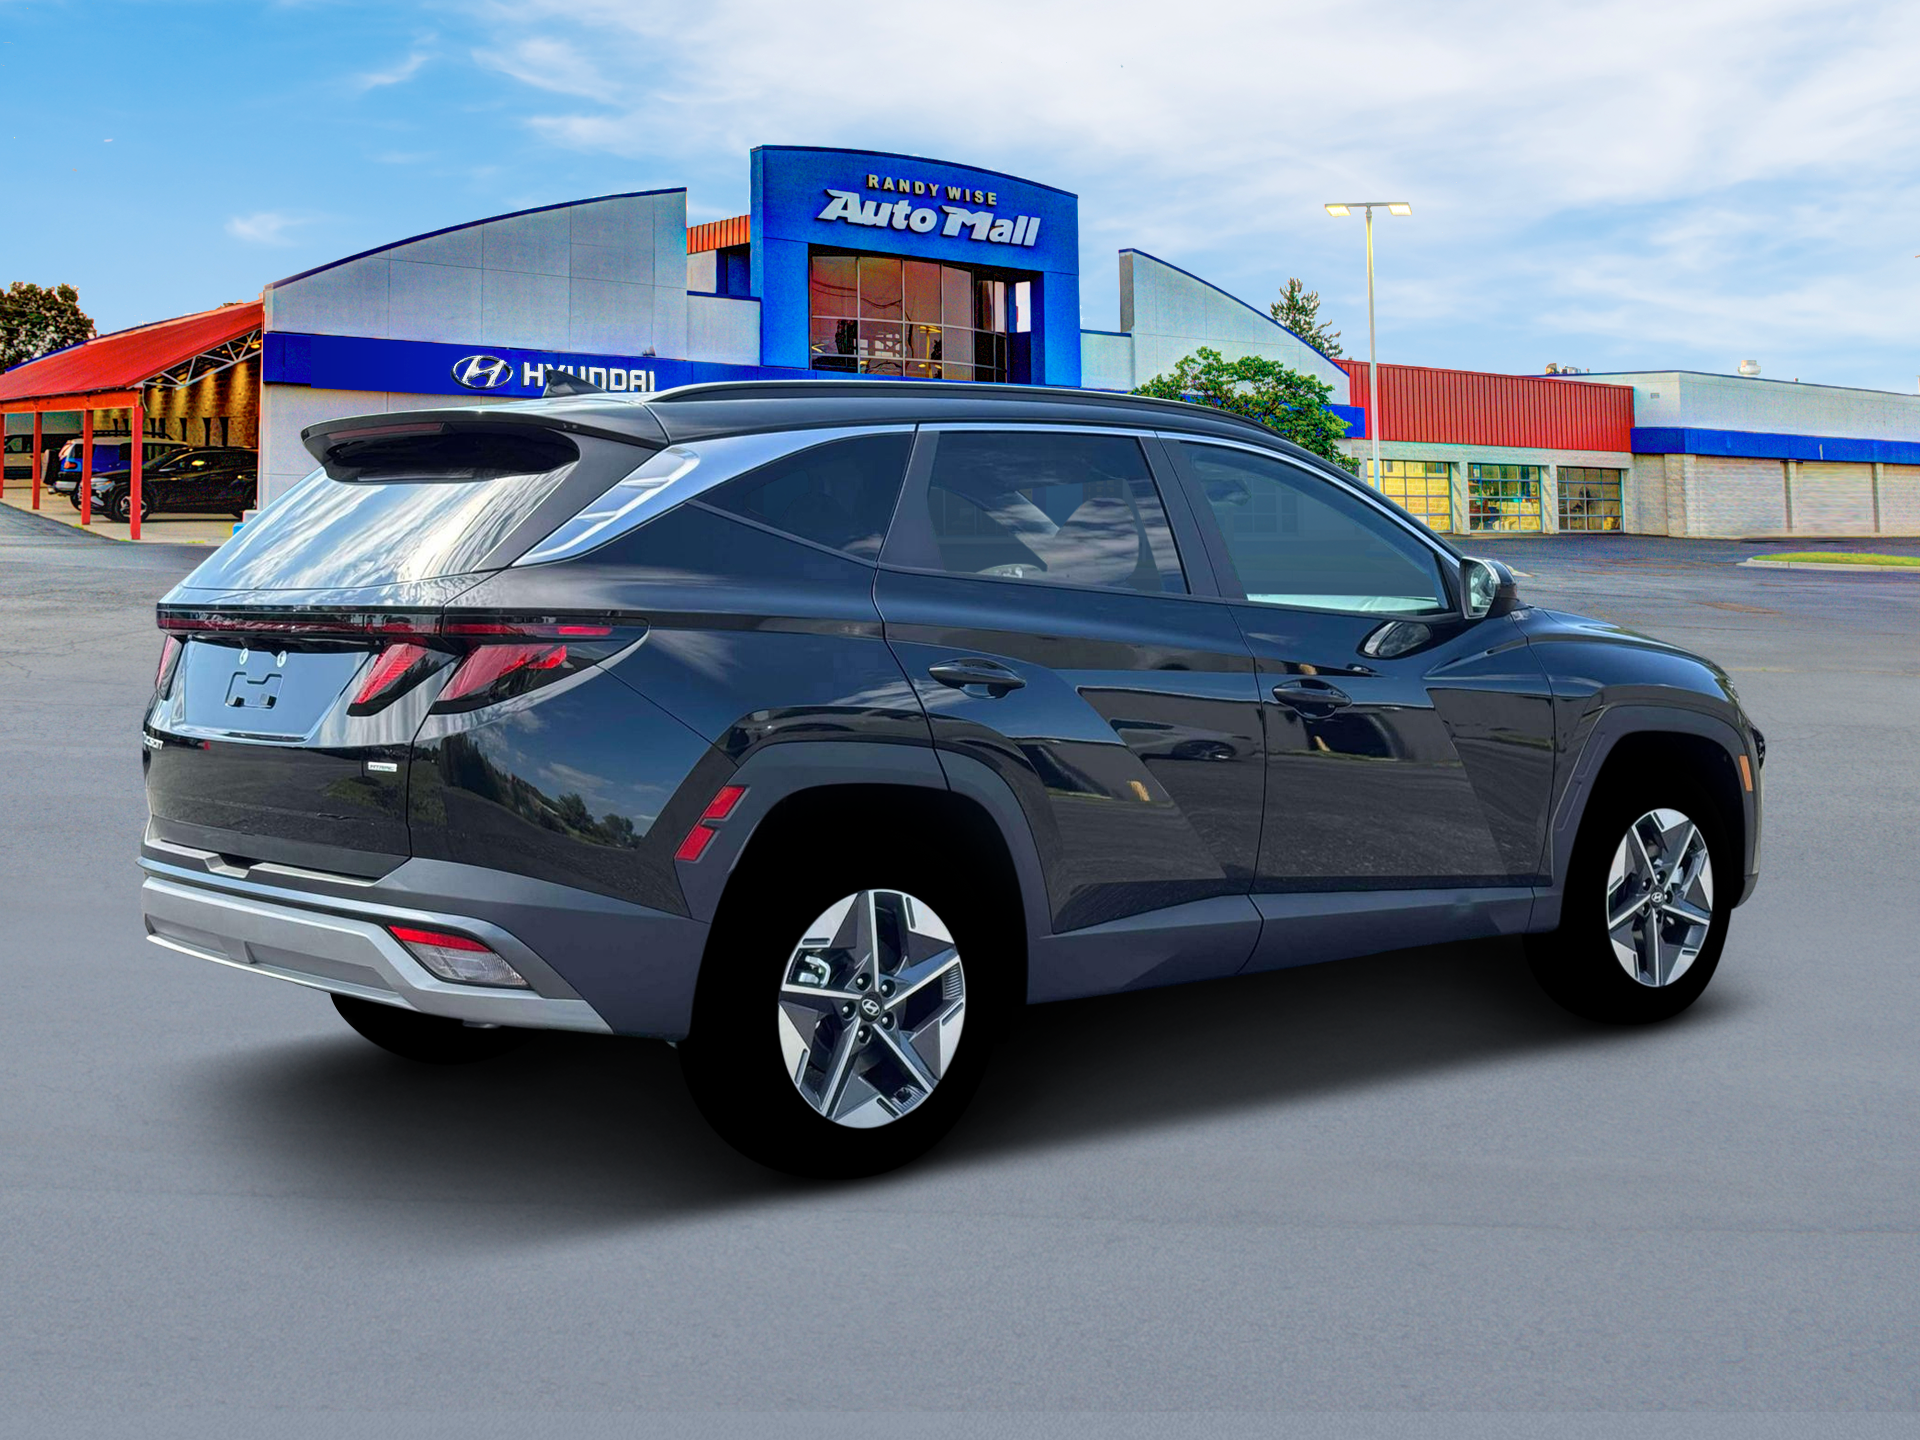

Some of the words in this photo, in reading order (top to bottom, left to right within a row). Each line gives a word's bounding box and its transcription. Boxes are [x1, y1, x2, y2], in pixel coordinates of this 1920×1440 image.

[868, 174, 939, 197] RANDY
[946, 186, 997, 206] WISE
[817, 188, 938, 233] Auto
[941, 205, 1041, 246] Mall
